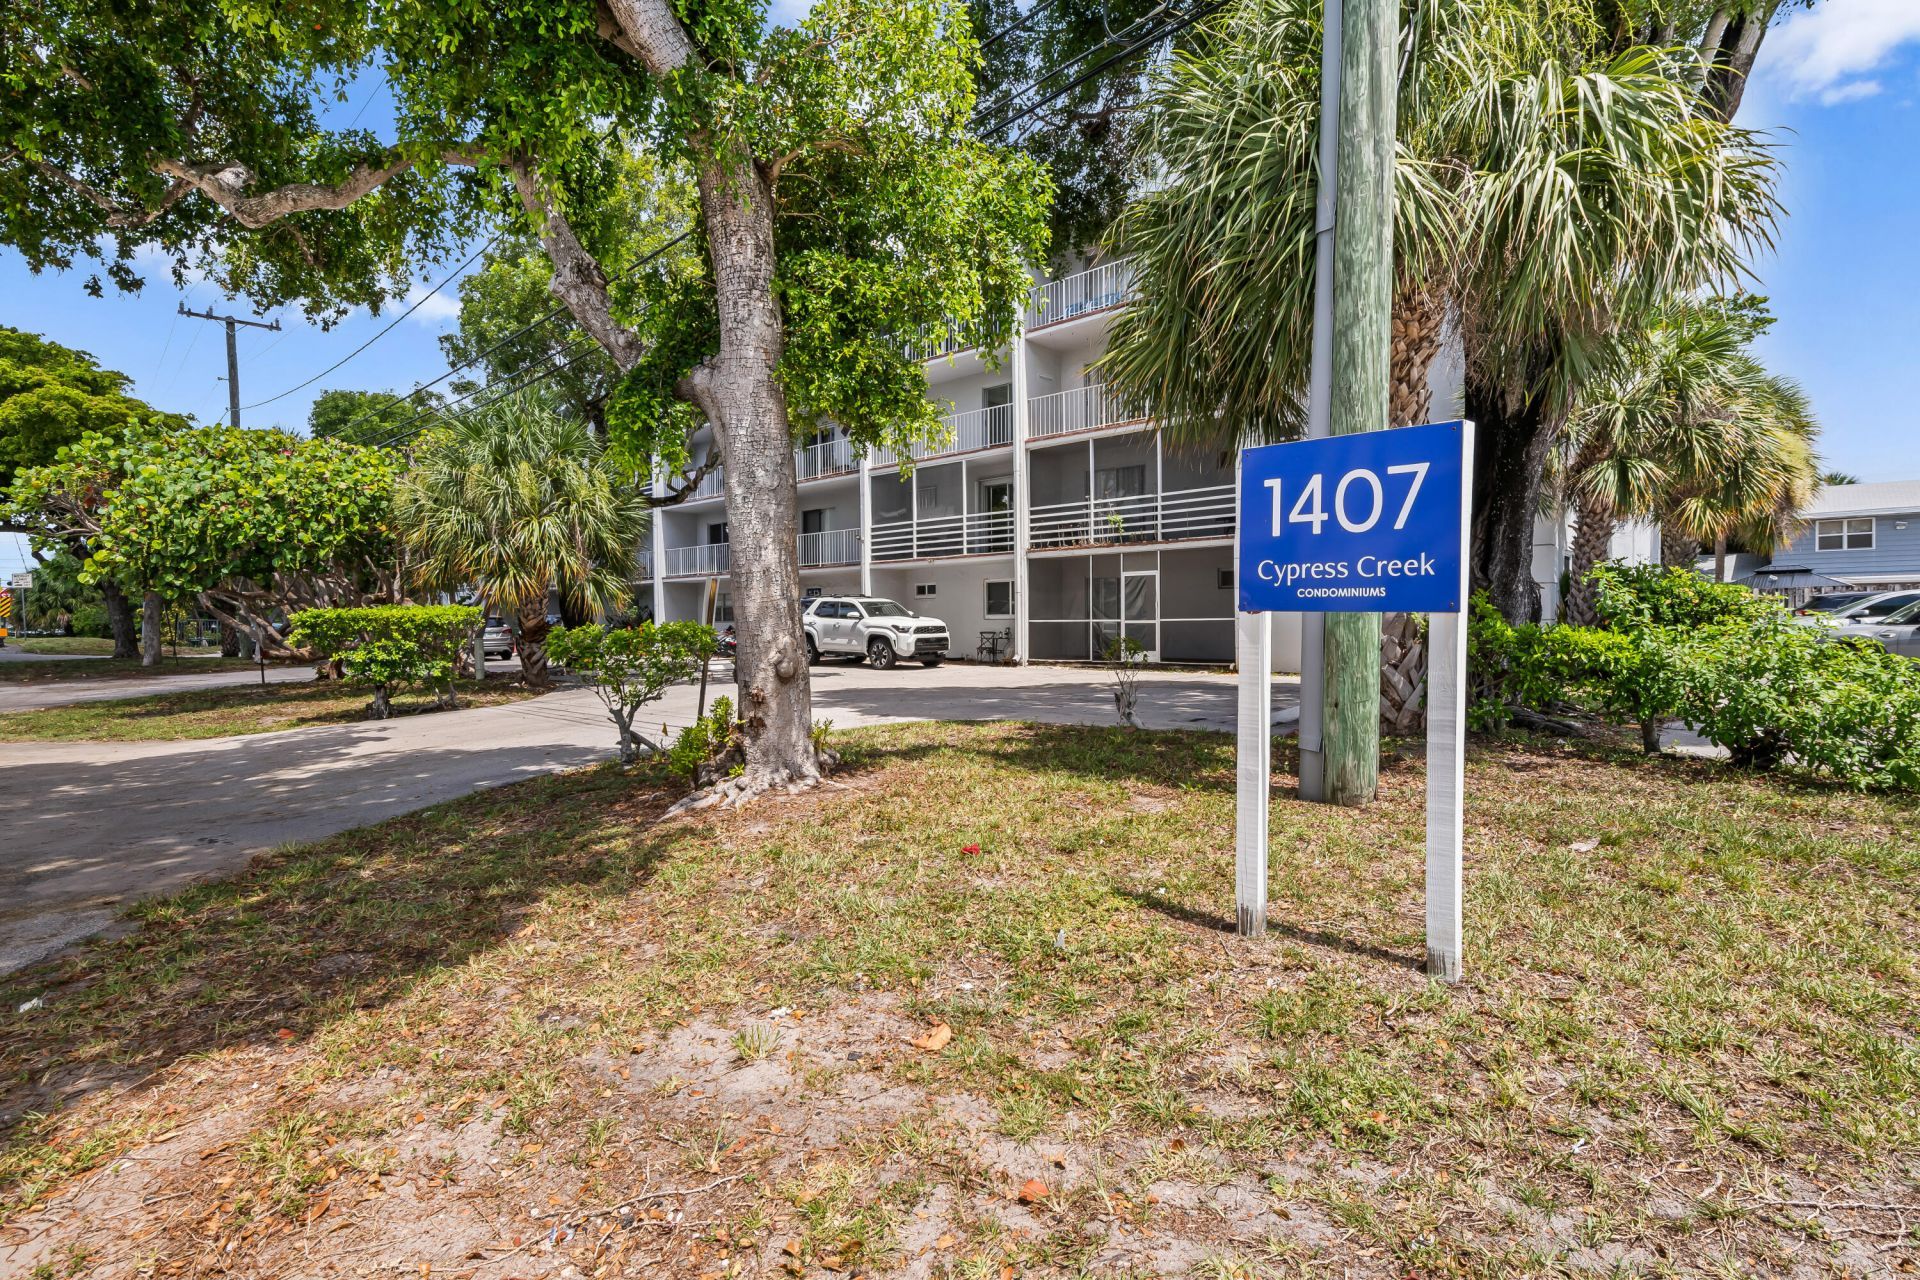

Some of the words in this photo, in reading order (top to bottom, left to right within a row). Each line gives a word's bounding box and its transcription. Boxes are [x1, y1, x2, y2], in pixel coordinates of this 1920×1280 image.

[1263, 462, 1430, 537] 1407
[1257, 559, 1349, 586] Cypress
[1357, 552, 1436, 577] Creek
[1297, 587, 1386, 598] CONDOMINIUMS
